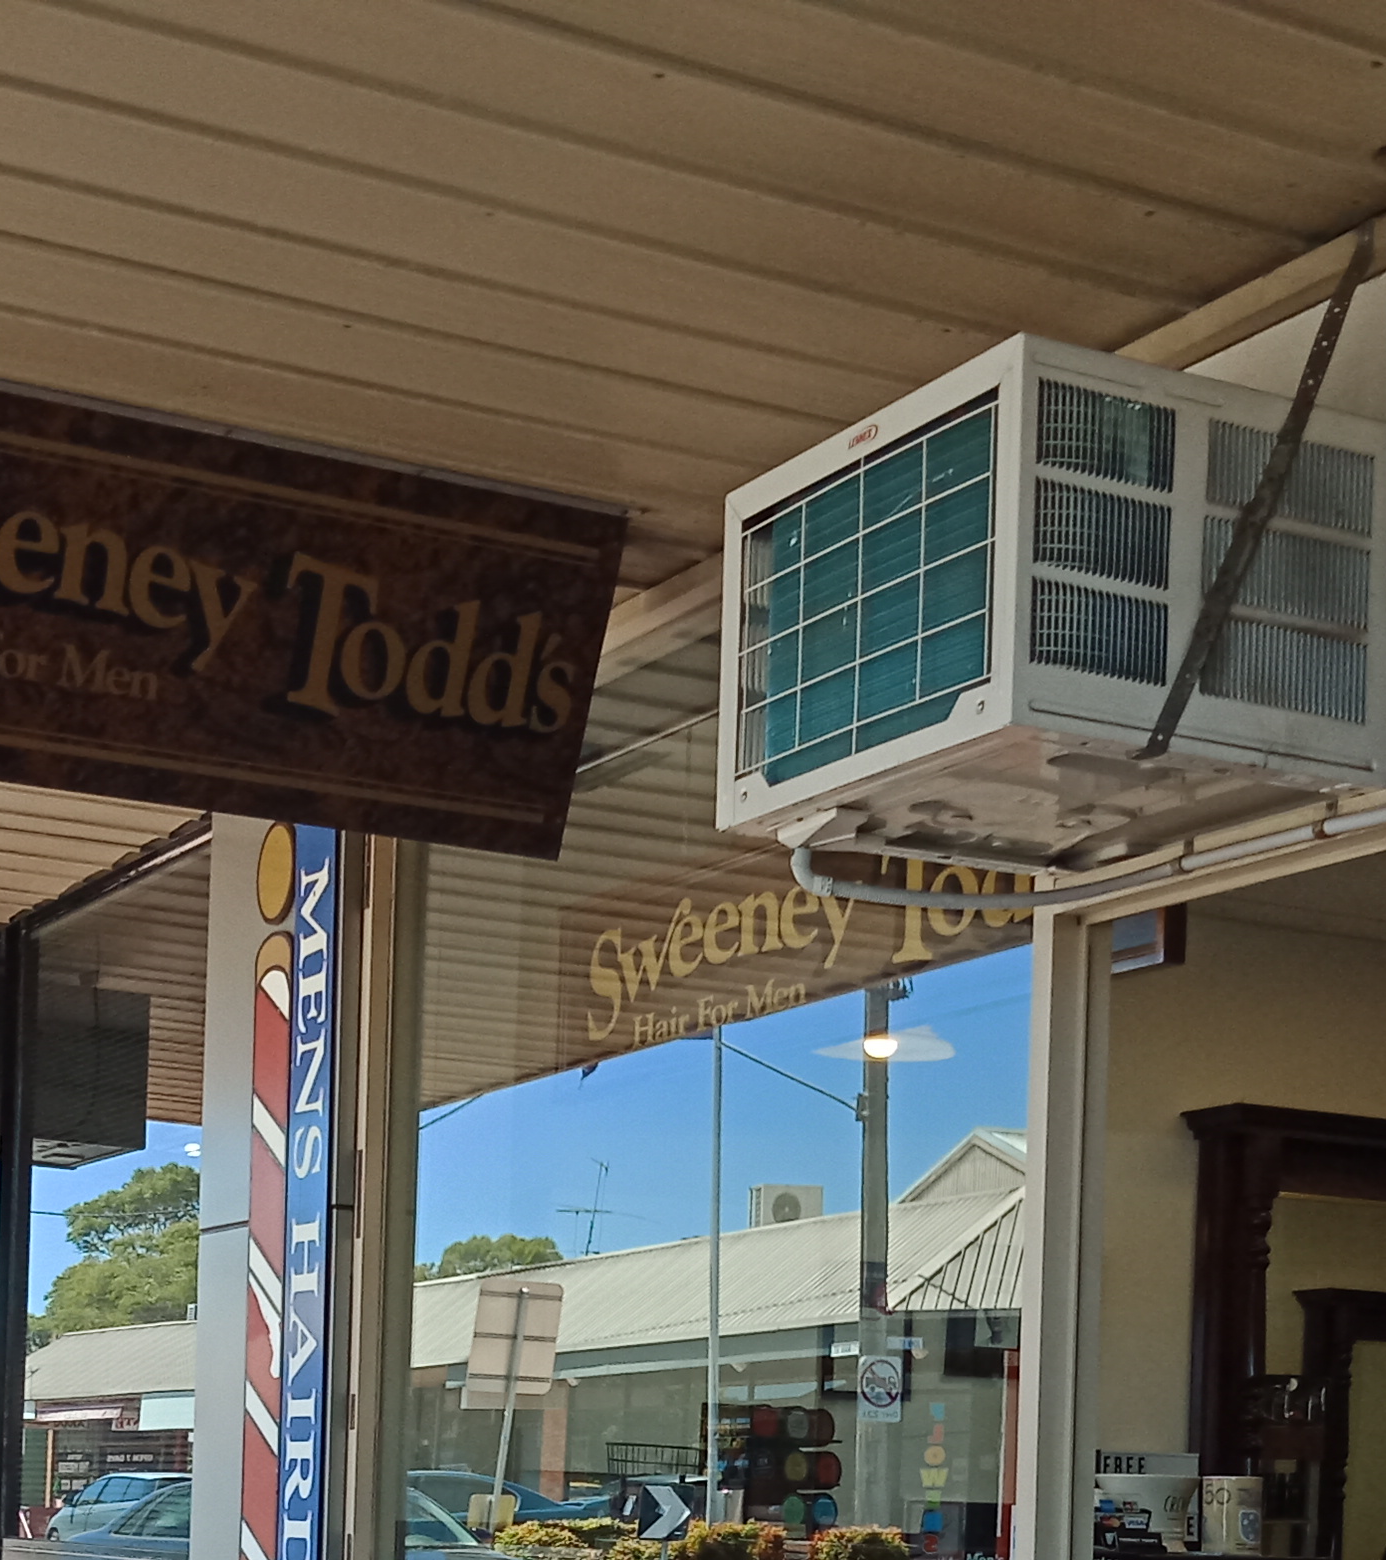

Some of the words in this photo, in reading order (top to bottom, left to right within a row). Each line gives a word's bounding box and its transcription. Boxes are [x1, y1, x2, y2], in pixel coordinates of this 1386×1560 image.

[56, 644, 160, 701] Men
[286, 551, 576, 733] Todd's
[292, 857, 331, 1180] MENS
[587, 880, 862, 1042] Sweeney
[632, 1010, 690, 1050] Hair
[697, 994, 738, 1028] For
[745, 978, 807, 1019] Men
[1103, 1456, 1146, 1474] FREE
